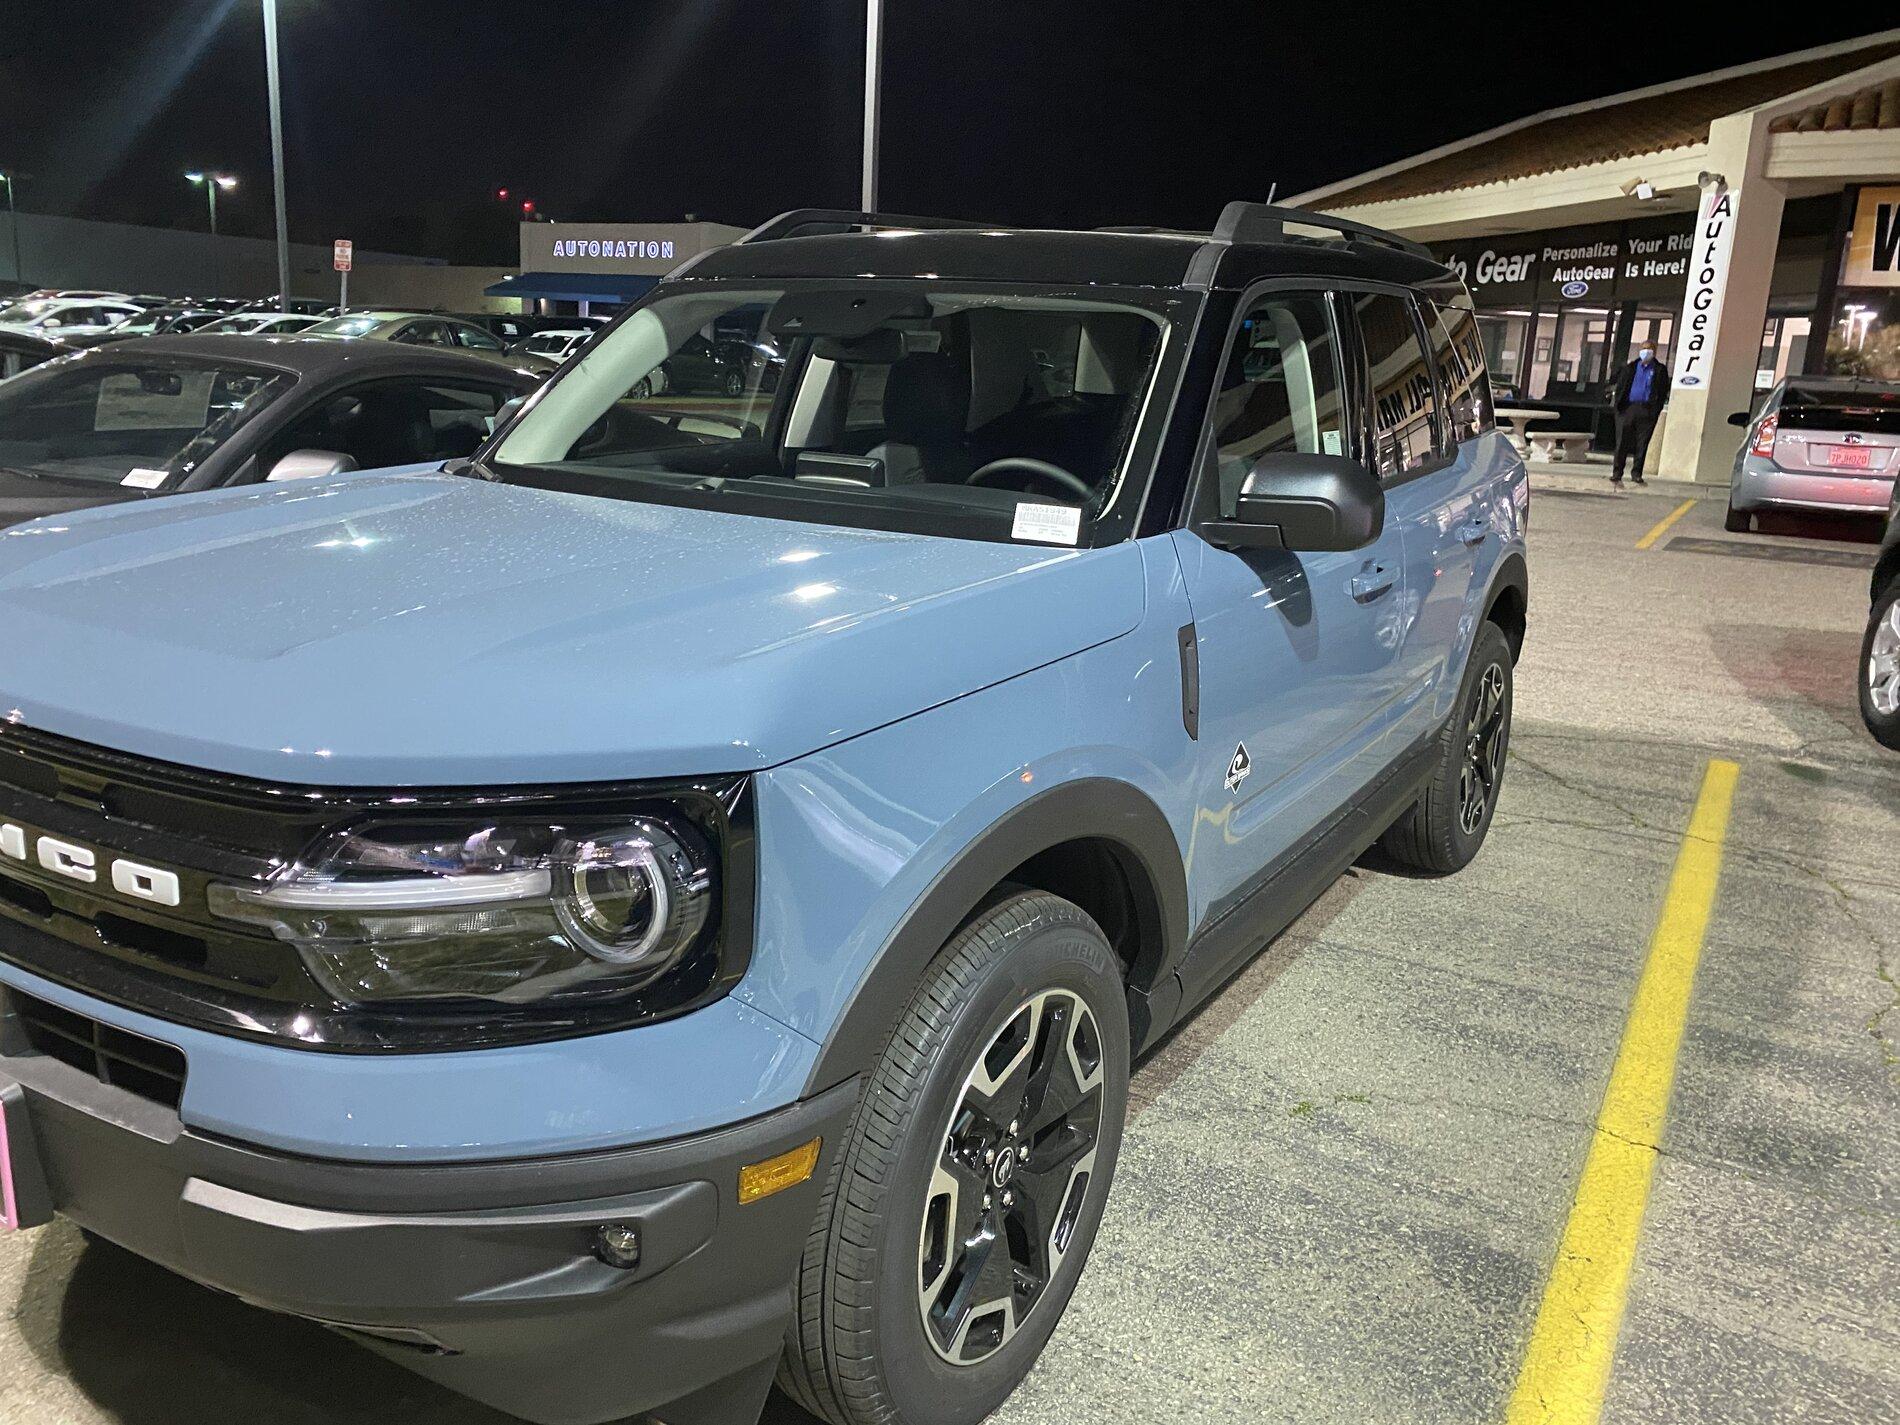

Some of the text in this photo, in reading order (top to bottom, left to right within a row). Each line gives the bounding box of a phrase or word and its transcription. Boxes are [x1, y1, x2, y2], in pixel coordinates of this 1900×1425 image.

[553, 240, 673, 259] AUTONATION
[1542, 242, 1618, 262] Personalize
[1628, 238, 1663, 255] Your
[1444, 250, 1536, 284] to Gear
[1552, 258, 1687, 283] AutoGear Is Here!
[1686, 194, 1731, 373] AutoGear
